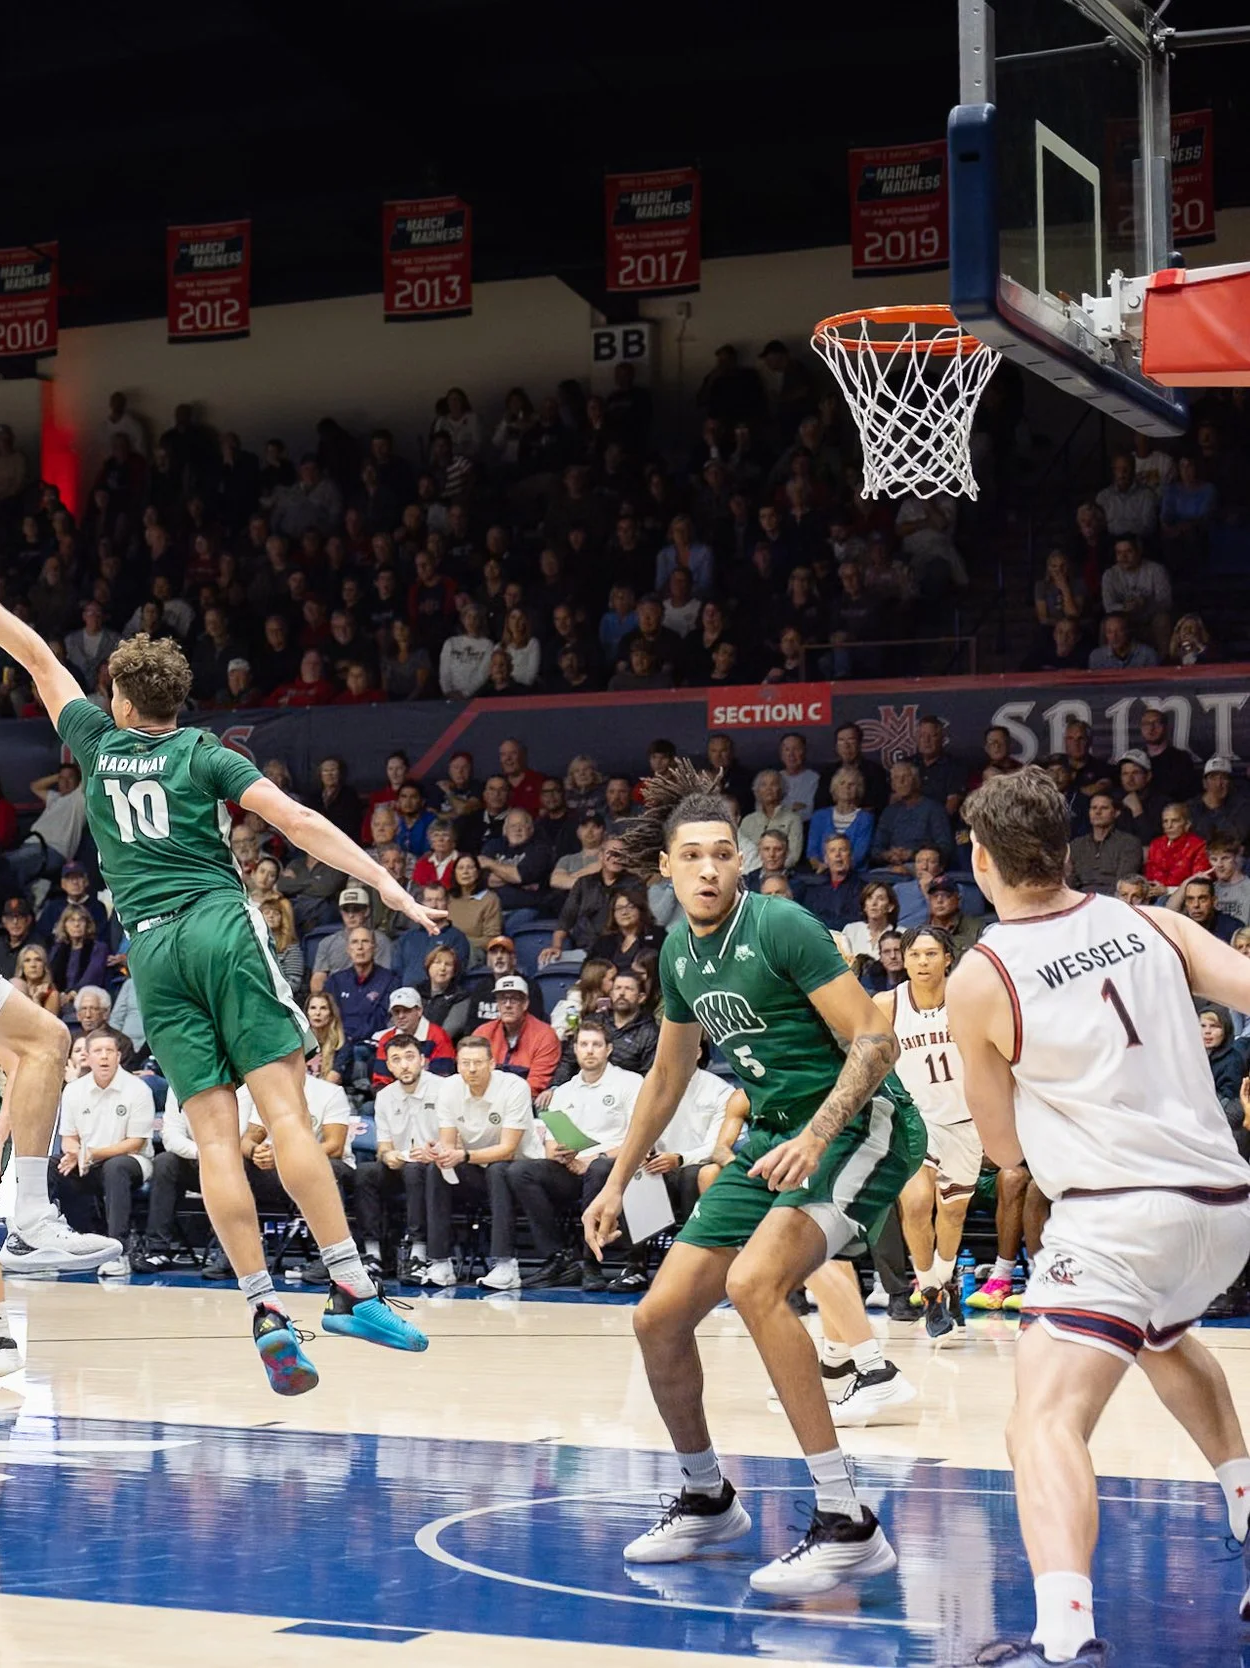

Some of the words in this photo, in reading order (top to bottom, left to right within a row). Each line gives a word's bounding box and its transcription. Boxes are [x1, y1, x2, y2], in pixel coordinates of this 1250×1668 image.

[876, 163, 921, 181] MARCH
[880, 174, 941, 195] MADNESS
[629, 189, 672, 206] MARCH
[634, 200, 692, 220] MADNESS
[405, 216, 445, 232] MARCH
[410, 226, 463, 244] MADNESS
[863, 225, 940, 264] 2019
[188, 241, 226, 256] MARCH
[193, 251, 242, 268] MADNESS
[618, 249, 688, 286] 2017
[0, 264, 36, 280] MARCH
[3, 273, 51, 292] MADNESS
[394, 273, 461, 309] 2013
[177, 298, 241, 331] 2012
[593, 329, 646, 361] BB
[713, 703, 803, 725] SECTION
[807, 702, 822, 721] C
[97, 754, 168, 774] HADAWAY
[102, 778, 171, 844] 10
[1036, 933, 1146, 990] WESSELS
[1100, 977, 1144, 1049] 1
[900, 1033, 927, 1051] SAINT
[733, 1044, 767, 1079] 5
[924, 1050, 954, 1085] 11
